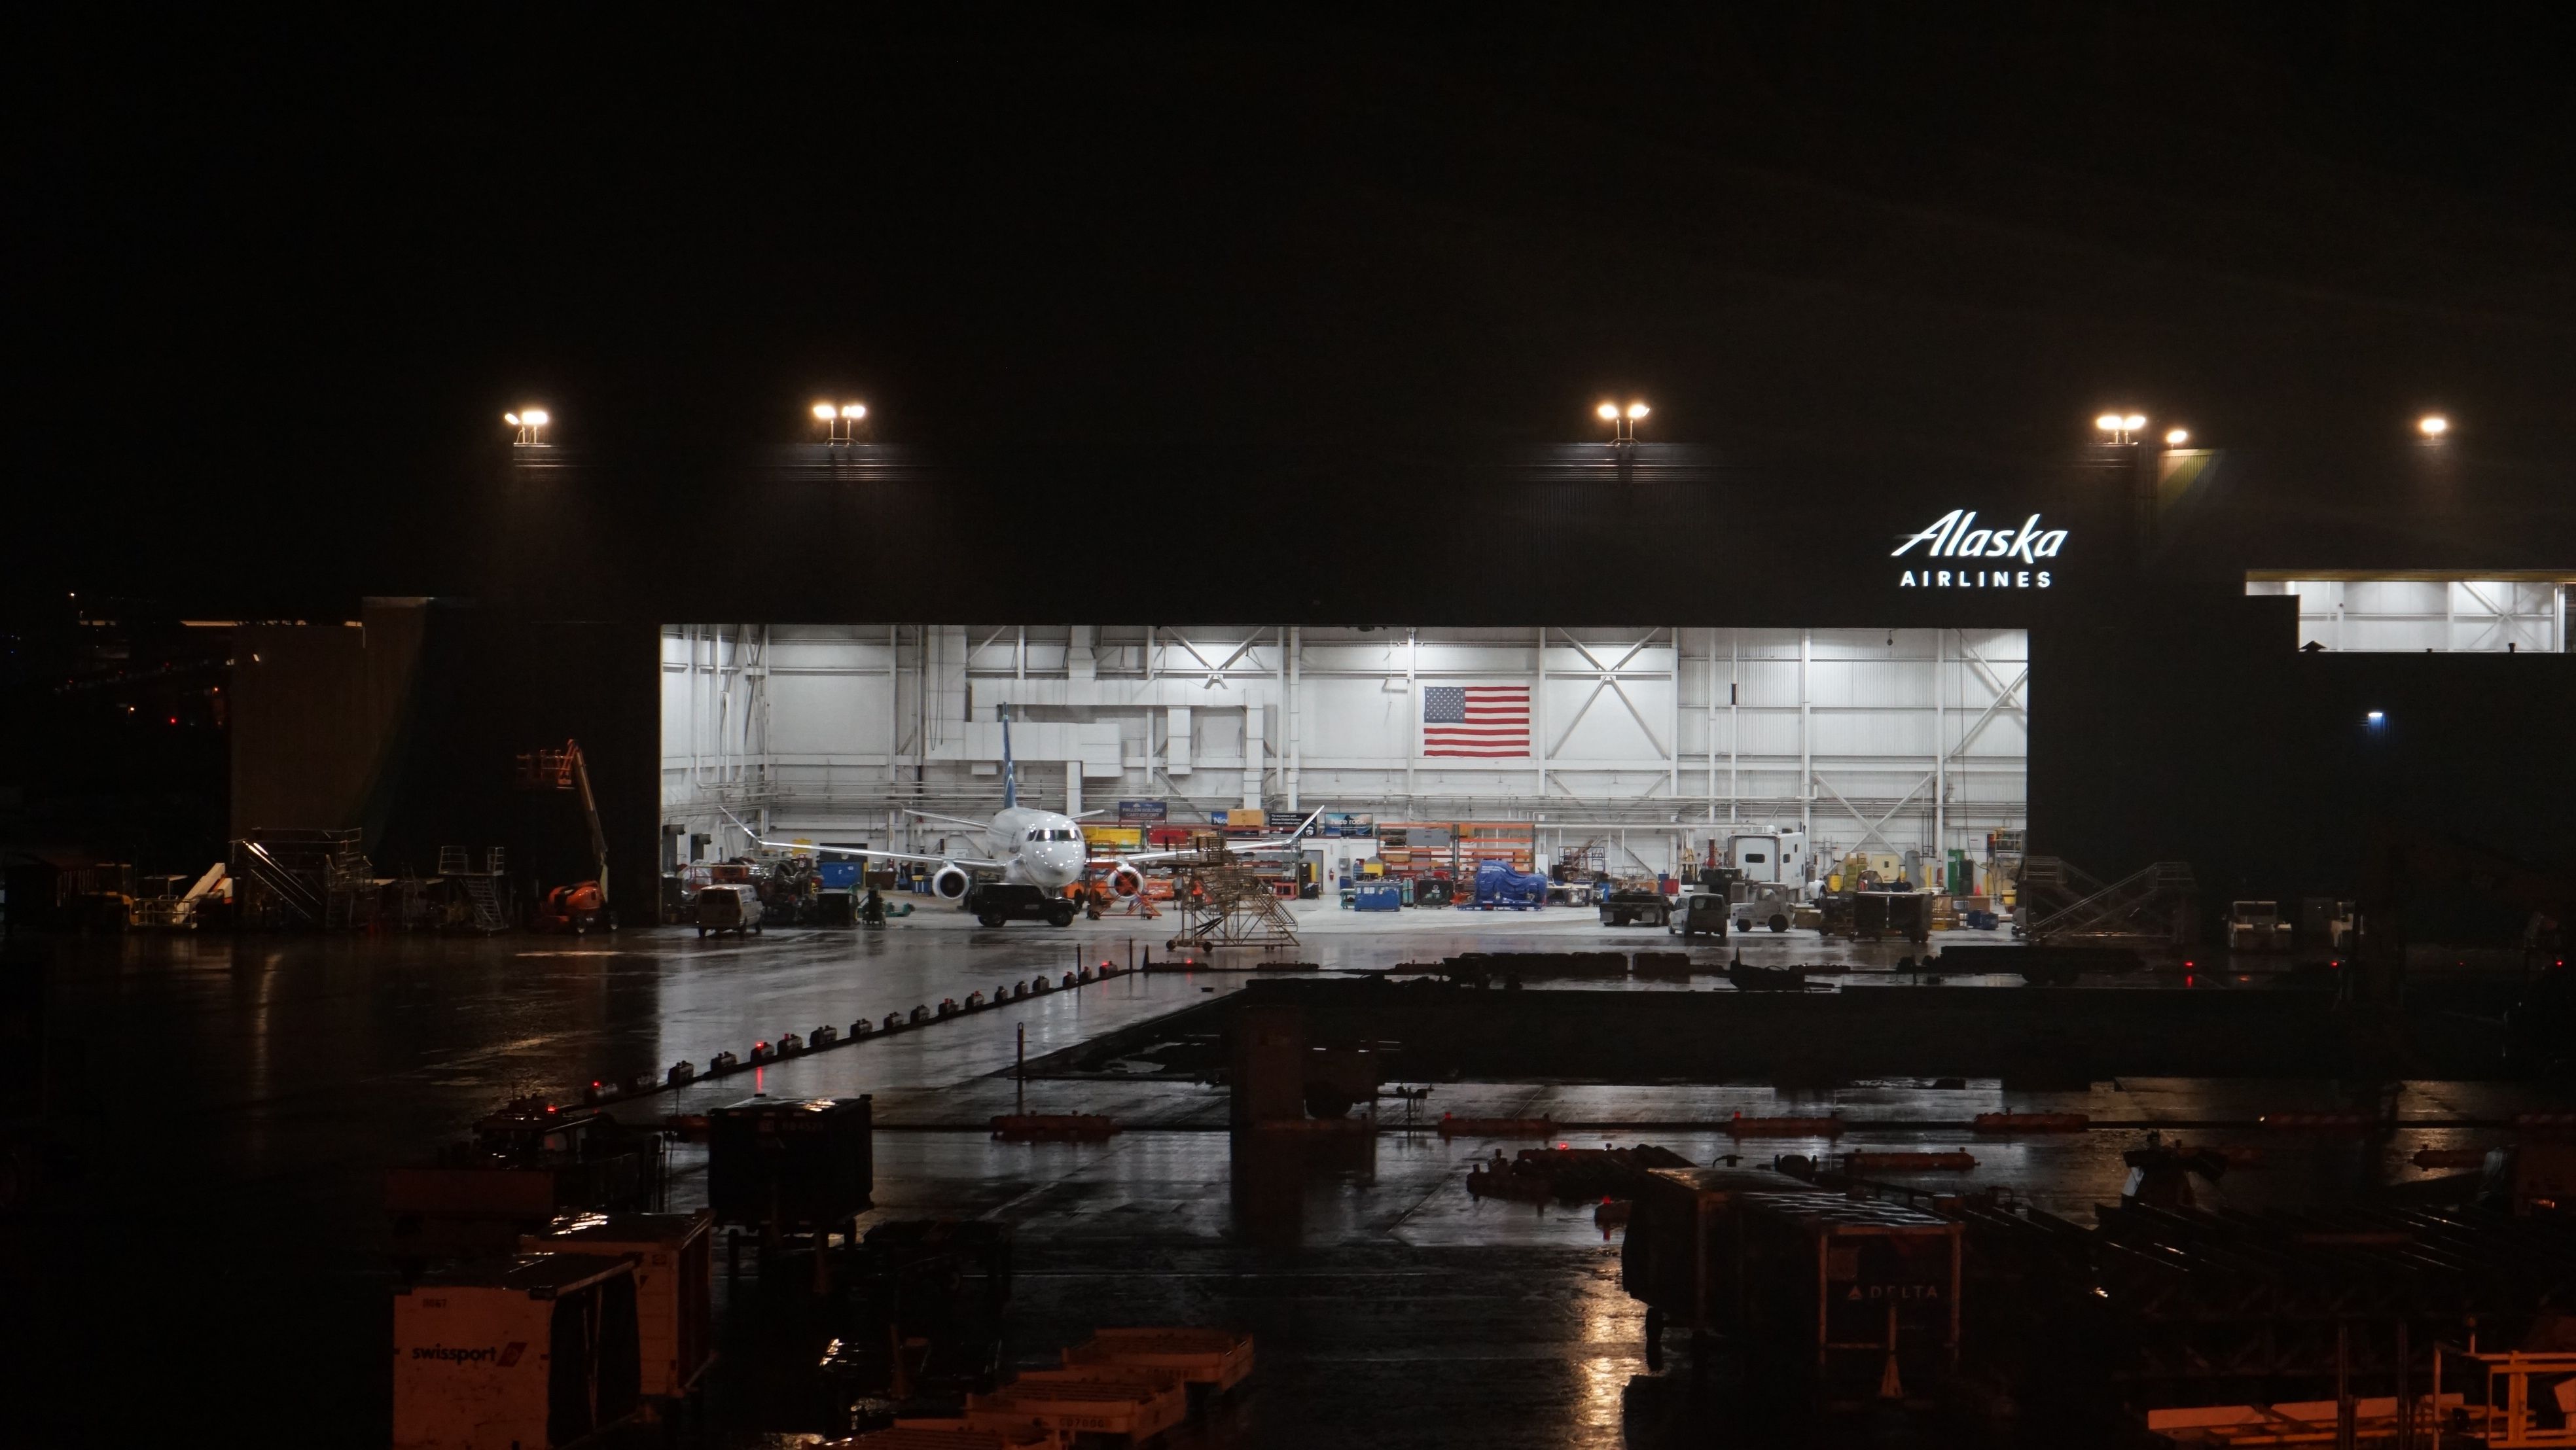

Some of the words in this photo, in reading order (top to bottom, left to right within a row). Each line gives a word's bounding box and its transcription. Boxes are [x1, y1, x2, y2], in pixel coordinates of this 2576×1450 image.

[1891, 509, 2068, 564] Alaska
[1900, 571, 2051, 588] AIRLINES
[1870, 1285, 1938, 1299] DELTA
[412, 1343, 497, 1366] swissport
